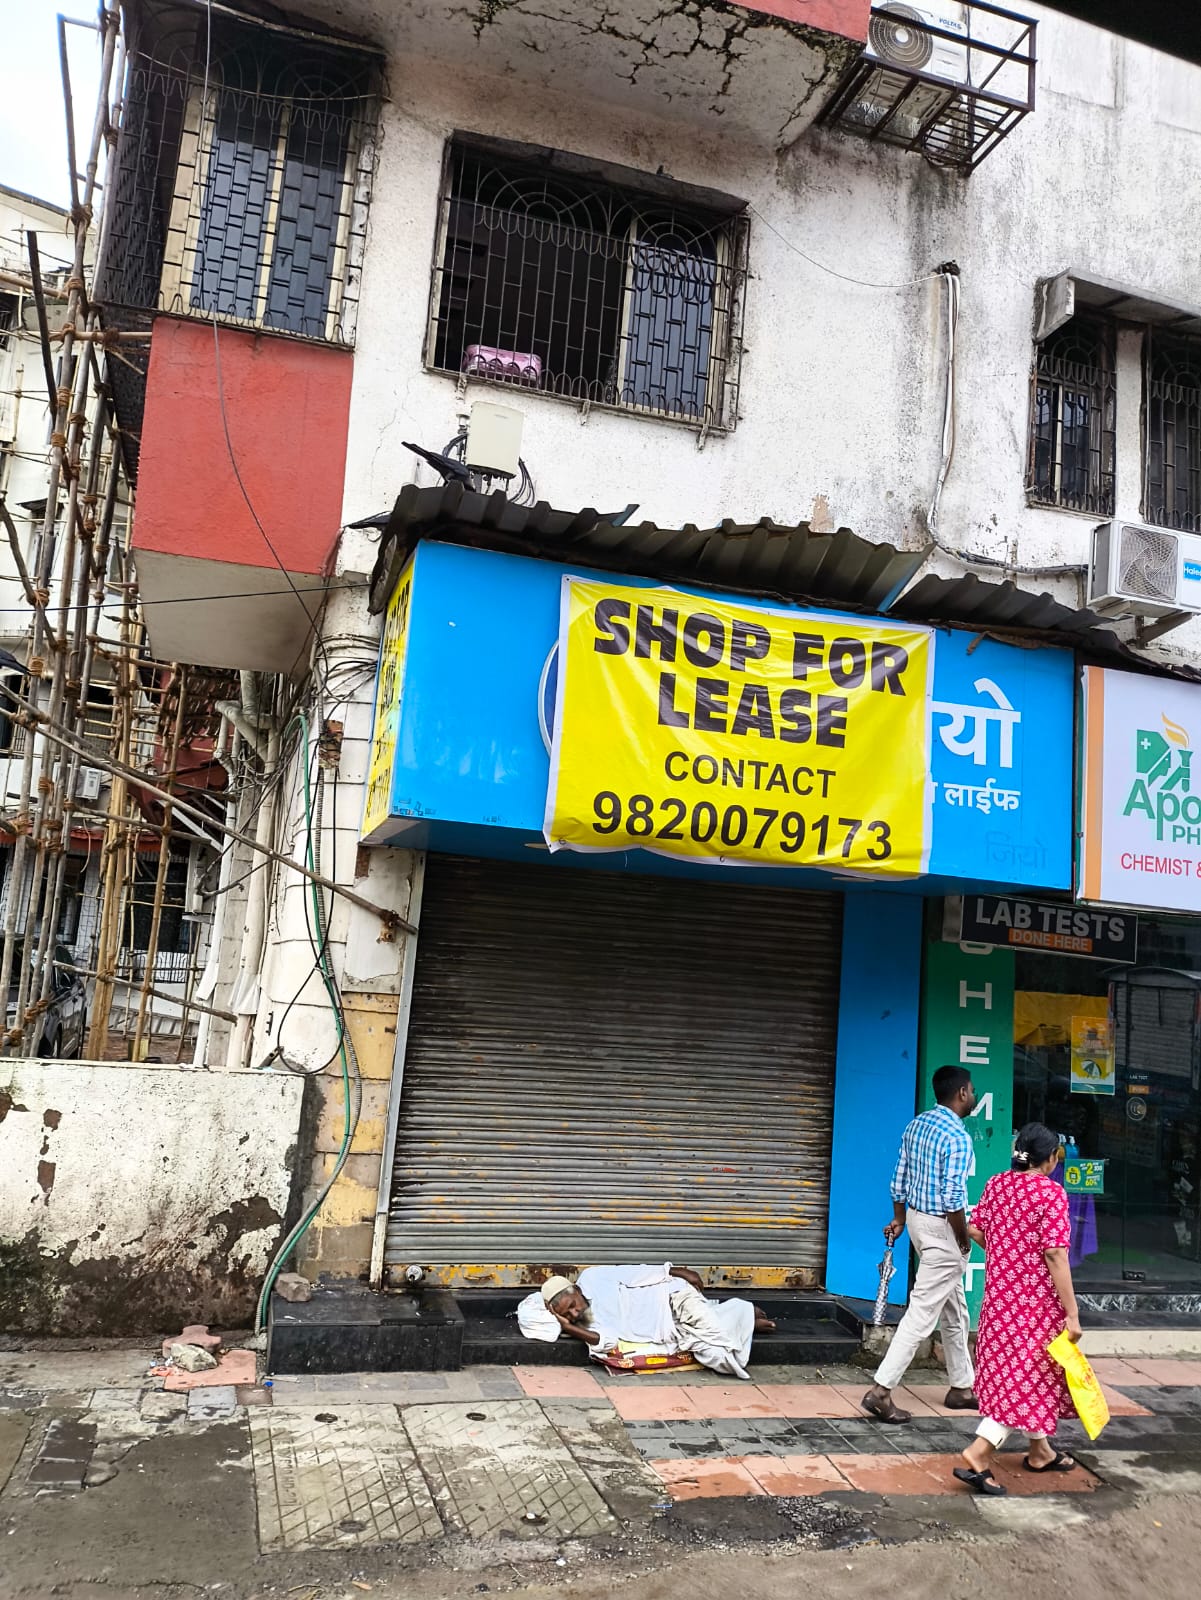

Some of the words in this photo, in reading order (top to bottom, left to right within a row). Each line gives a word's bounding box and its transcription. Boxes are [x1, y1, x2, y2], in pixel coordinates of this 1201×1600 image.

[594, 598, 771, 672] SHOP
[793, 631, 909, 696] FOR
[658, 672, 848, 748] LEASE
[664, 751, 836, 798] CONTACT
[943, 777, 1021, 814] लाईफ
[592, 791, 892, 861] 9820079173
[1123, 778, 1201, 841] Apo
[1172, 824, 1201, 846] PH
[1121, 852, 1192, 877] CHEMIST
[975, 898, 1032, 929] LAB
[1038, 906, 1125, 942] TESTS
[1012, 929, 1050, 946] DONE
[1053, 933, 1089, 951] HERE
